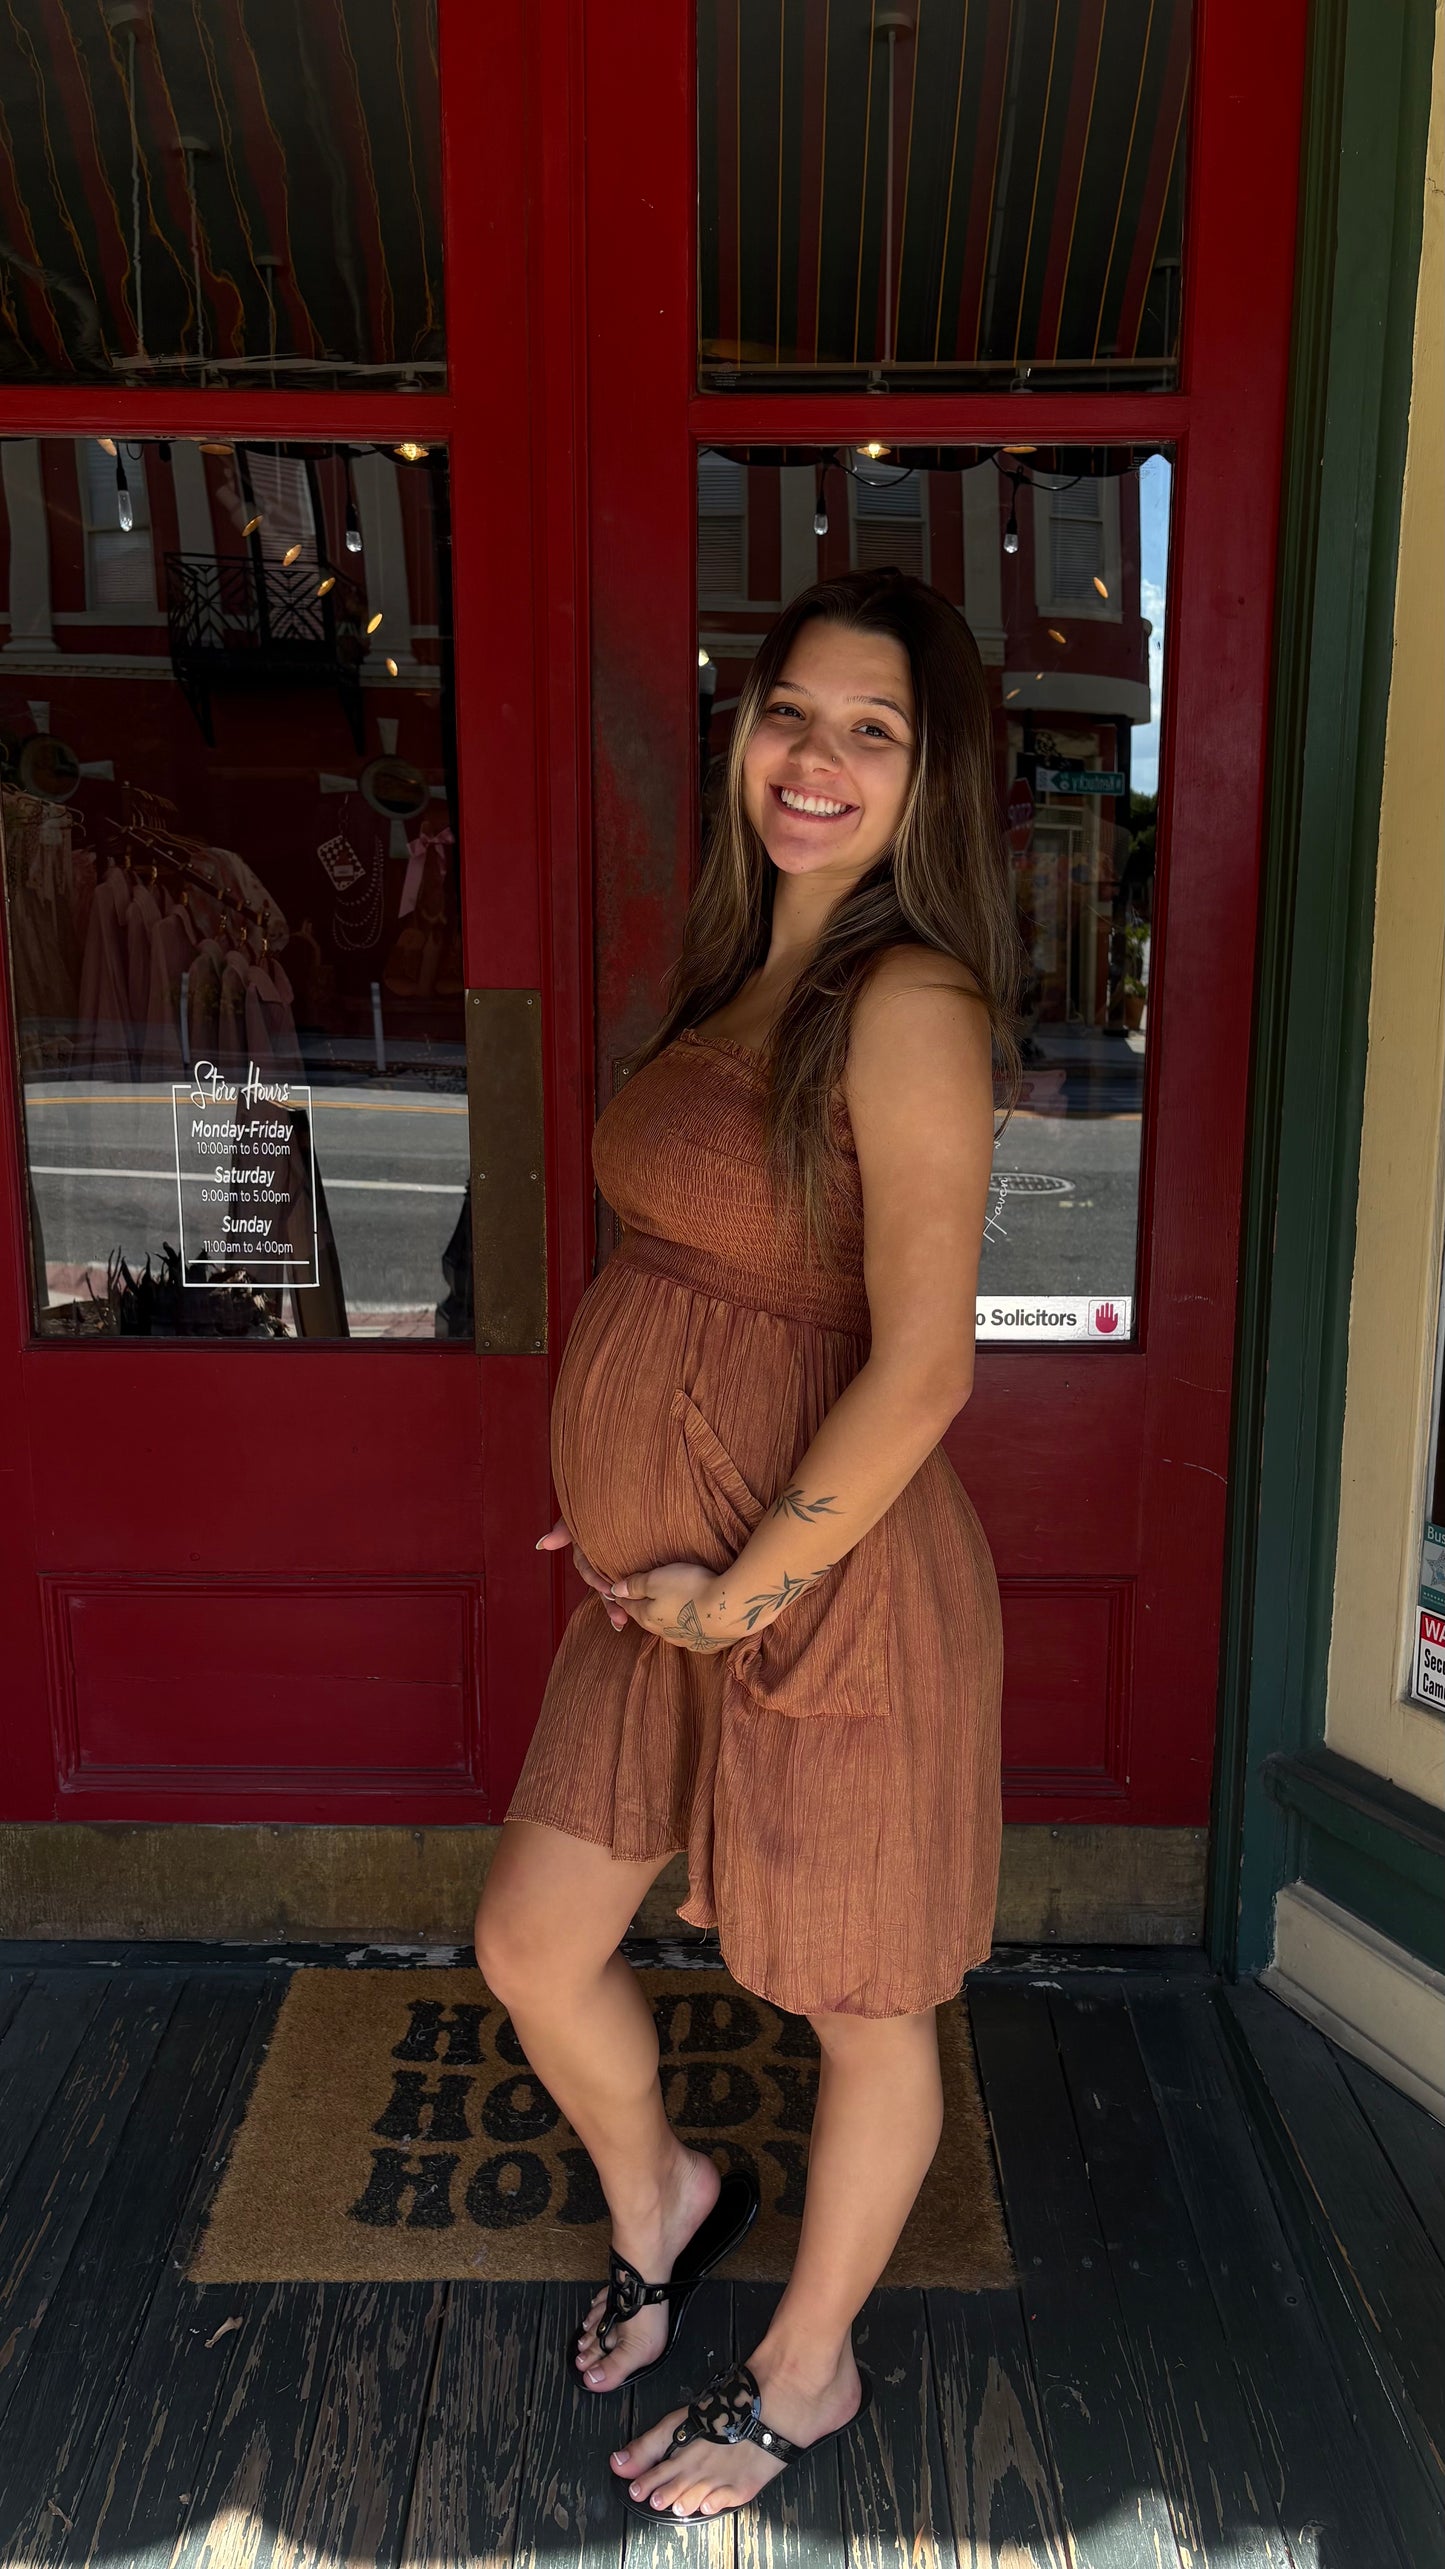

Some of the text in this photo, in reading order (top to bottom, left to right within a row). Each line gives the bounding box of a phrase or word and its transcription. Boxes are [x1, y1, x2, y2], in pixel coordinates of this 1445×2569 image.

[190, 1060, 291, 1110] Store Hours
[191, 1120, 294, 1141] Monday-Friday
[197, 1141, 237, 1155] 10:00am
[240, 1142, 250, 1155] to
[214, 1166, 275, 1187] Saturday
[201, 1189, 238, 1202] 9:00am
[240, 1190, 250, 1202] to
[222, 1216, 272, 1236] Sunday
[203, 1240, 240, 1253] 11:00am
[243, 1241, 253, 1253] to
[976, 1308, 1077, 1326] o Solicitors
